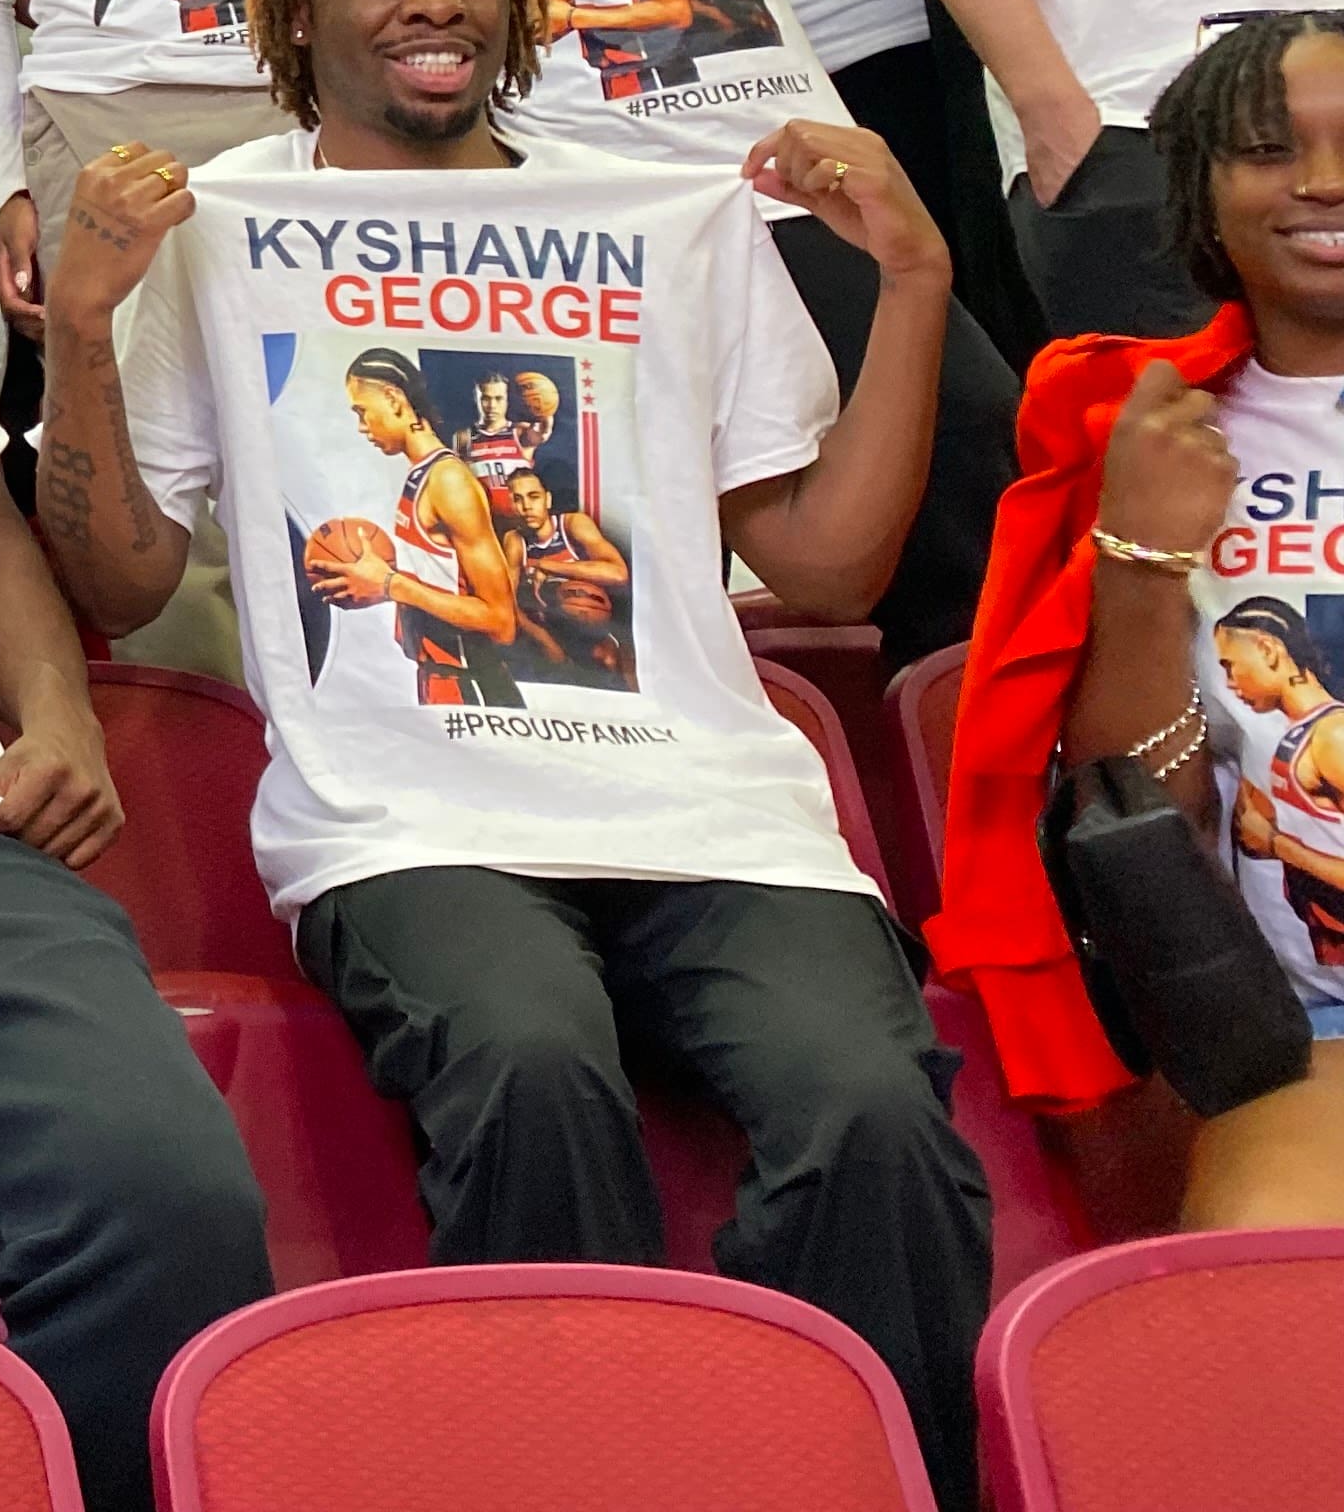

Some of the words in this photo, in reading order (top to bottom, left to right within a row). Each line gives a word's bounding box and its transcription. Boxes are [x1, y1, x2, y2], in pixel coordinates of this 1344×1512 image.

[627, 73, 813, 118] #PROUDFAMILY
[244, 216, 645, 287] KYSHAWN
[324, 273, 643, 345] GEORGE
[485, 462, 506, 488] 18
[444, 713, 679, 746] #PROUDFAMILY
